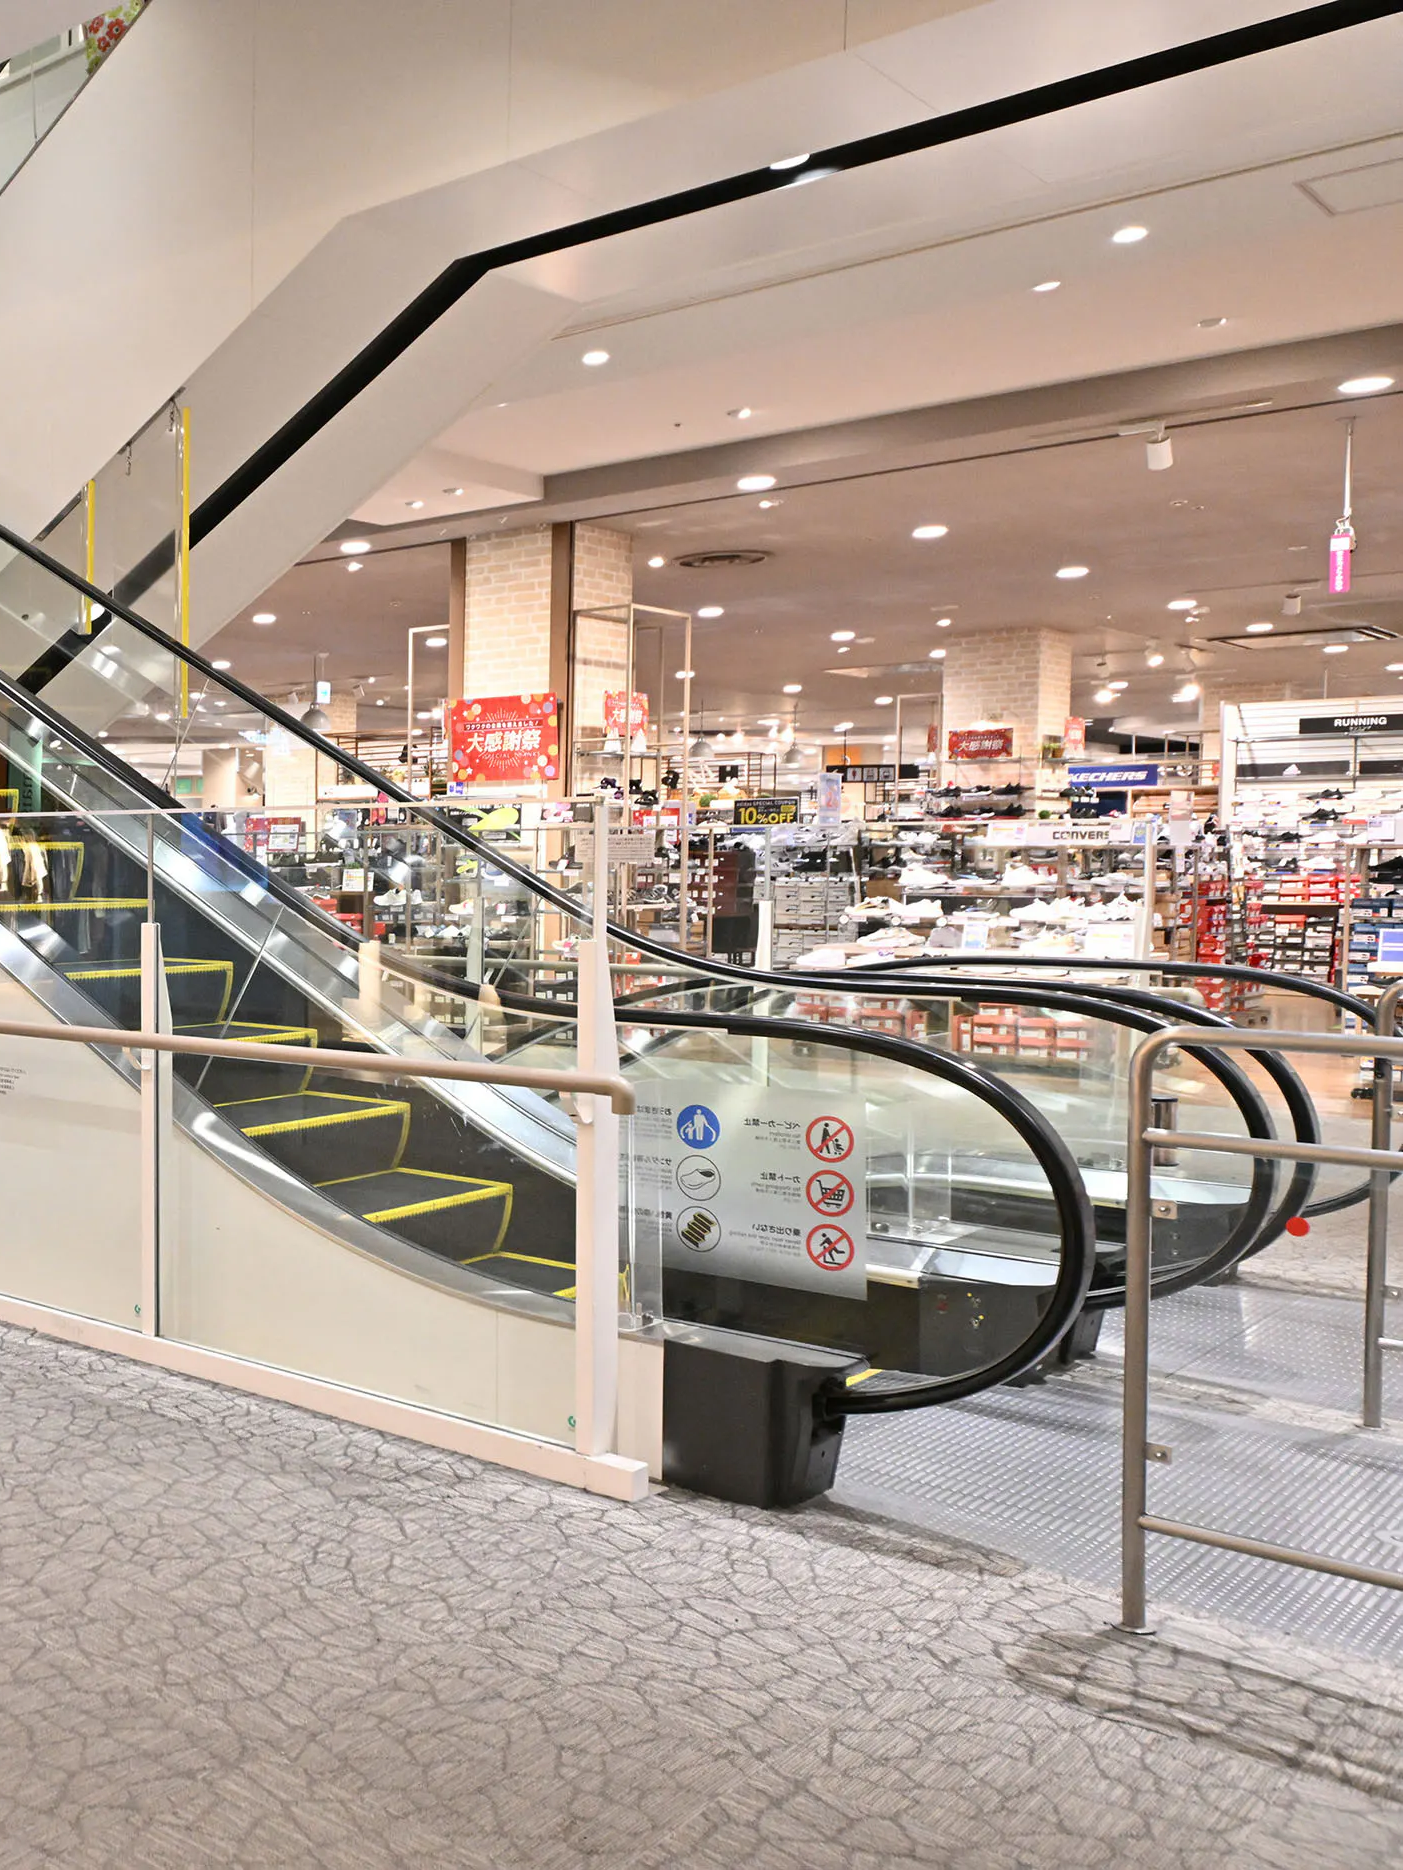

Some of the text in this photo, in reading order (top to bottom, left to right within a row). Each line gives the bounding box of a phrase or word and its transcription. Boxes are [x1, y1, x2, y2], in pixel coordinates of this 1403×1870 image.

[1334, 716, 1387, 727] RUNNING
[465, 729, 541, 753] 大感謝祭
[1069, 770, 1148, 782] KECHERS
[1052, 830, 1110, 841] CONVERS
